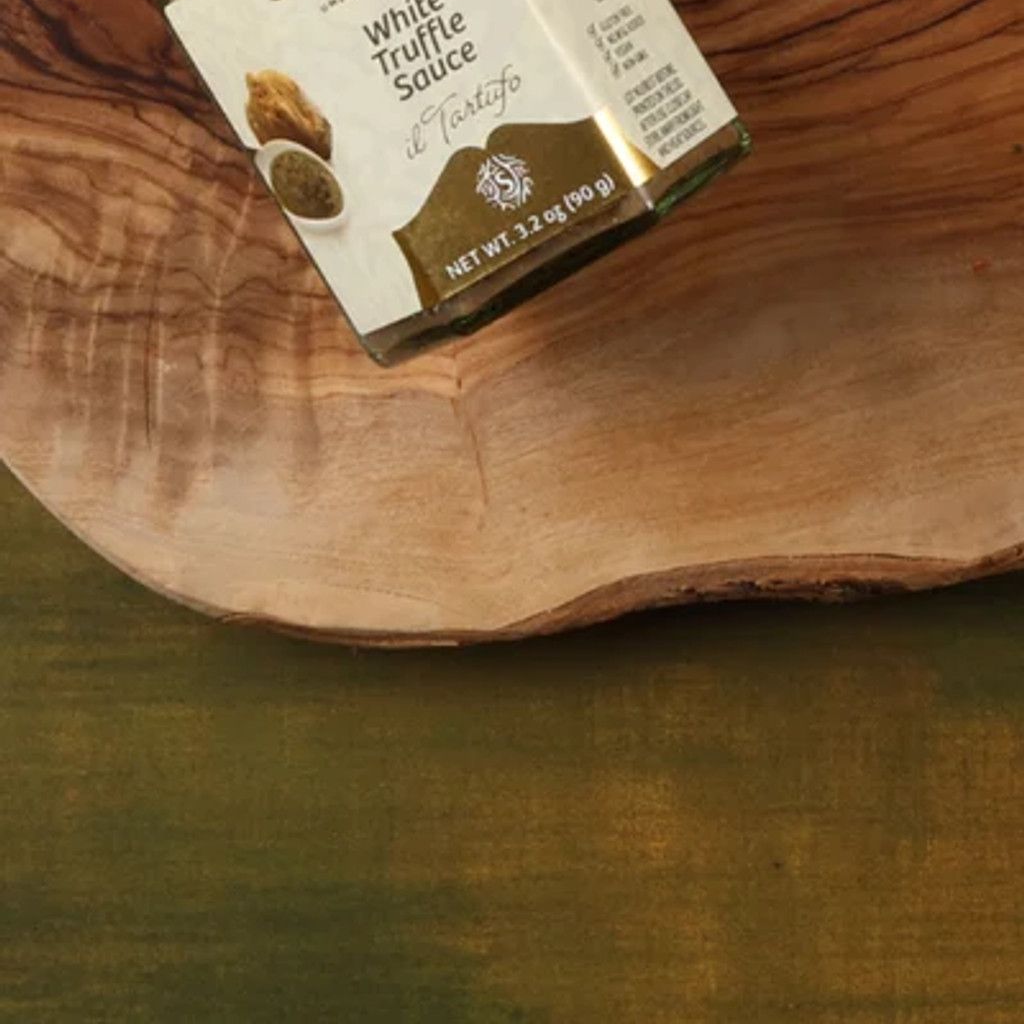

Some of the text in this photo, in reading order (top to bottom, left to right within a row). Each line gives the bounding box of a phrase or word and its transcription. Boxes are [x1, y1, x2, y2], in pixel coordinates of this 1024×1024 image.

[371, 12, 467, 76] Truffle
[394, 41, 477, 101] Sauce
[420, 63, 522, 145] Tartufo
[445, 248, 482, 280] NET
[481, 231, 516, 258] WT.
[514, 215, 544, 240] 3.2
[563, 184, 595, 213] (90
[594, 172, 616, 198] g)
